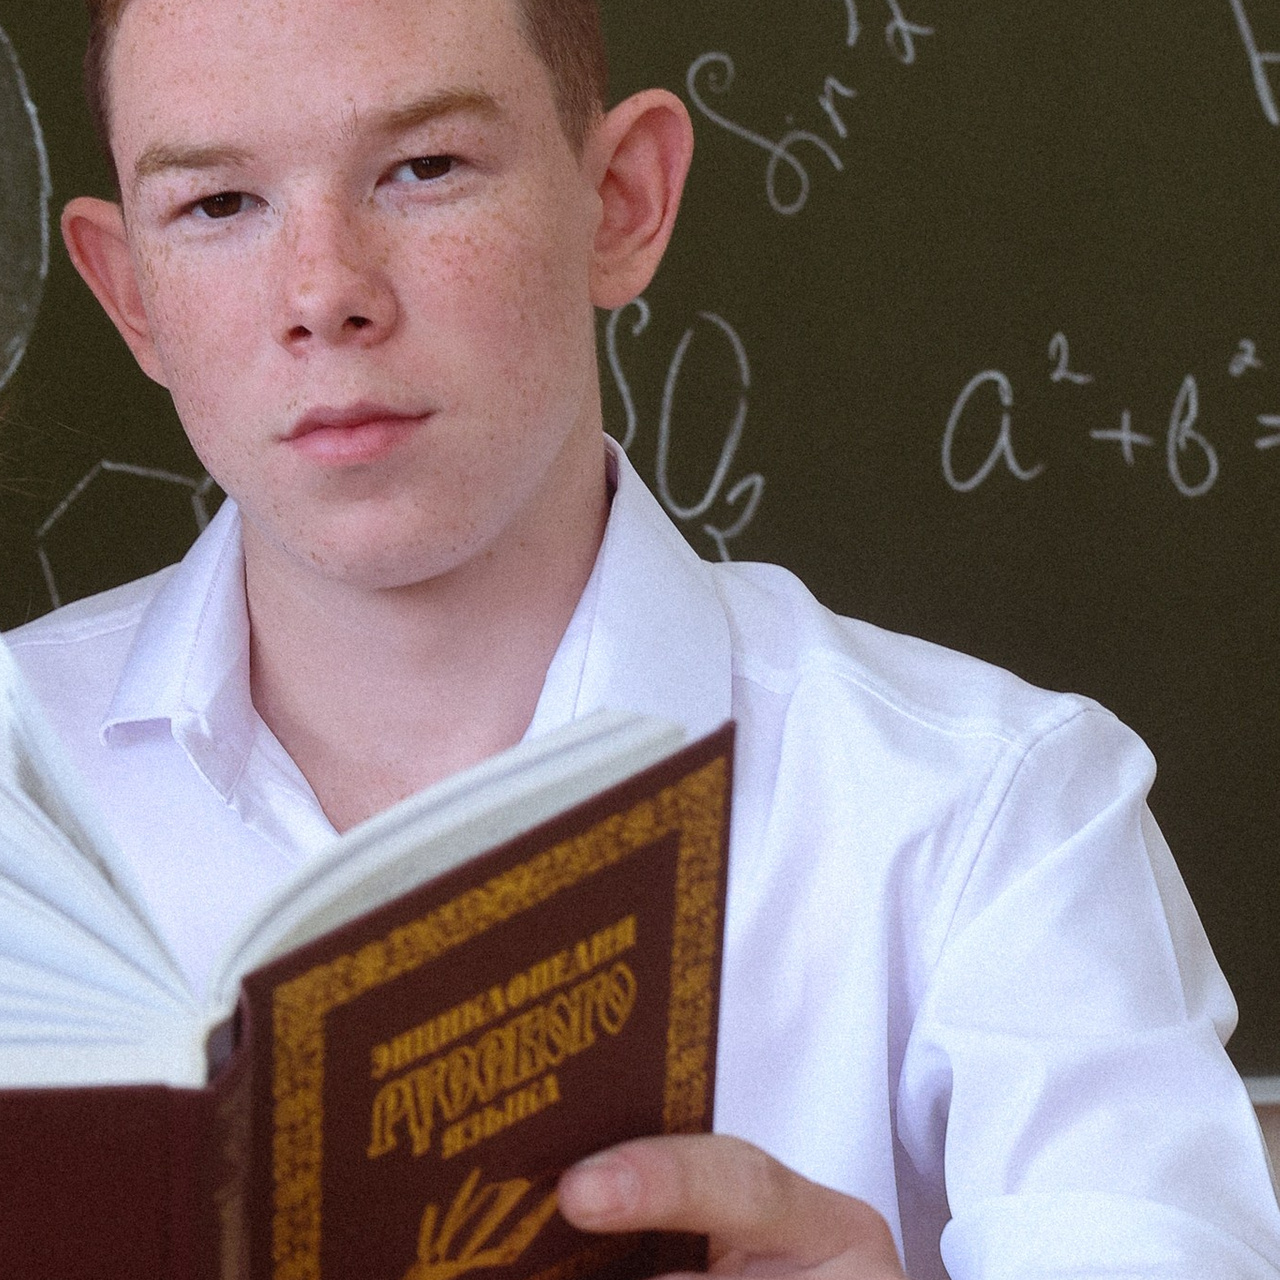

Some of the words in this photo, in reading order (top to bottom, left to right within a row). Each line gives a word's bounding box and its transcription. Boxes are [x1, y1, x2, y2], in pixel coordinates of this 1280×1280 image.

[366, 961, 639, 1159] РУССКОГО
[370, 912, 639, 1081] ЭНЦИКЛОПЕДИЯ
[441, 1072, 561, 1159] ЯЗЫКА
